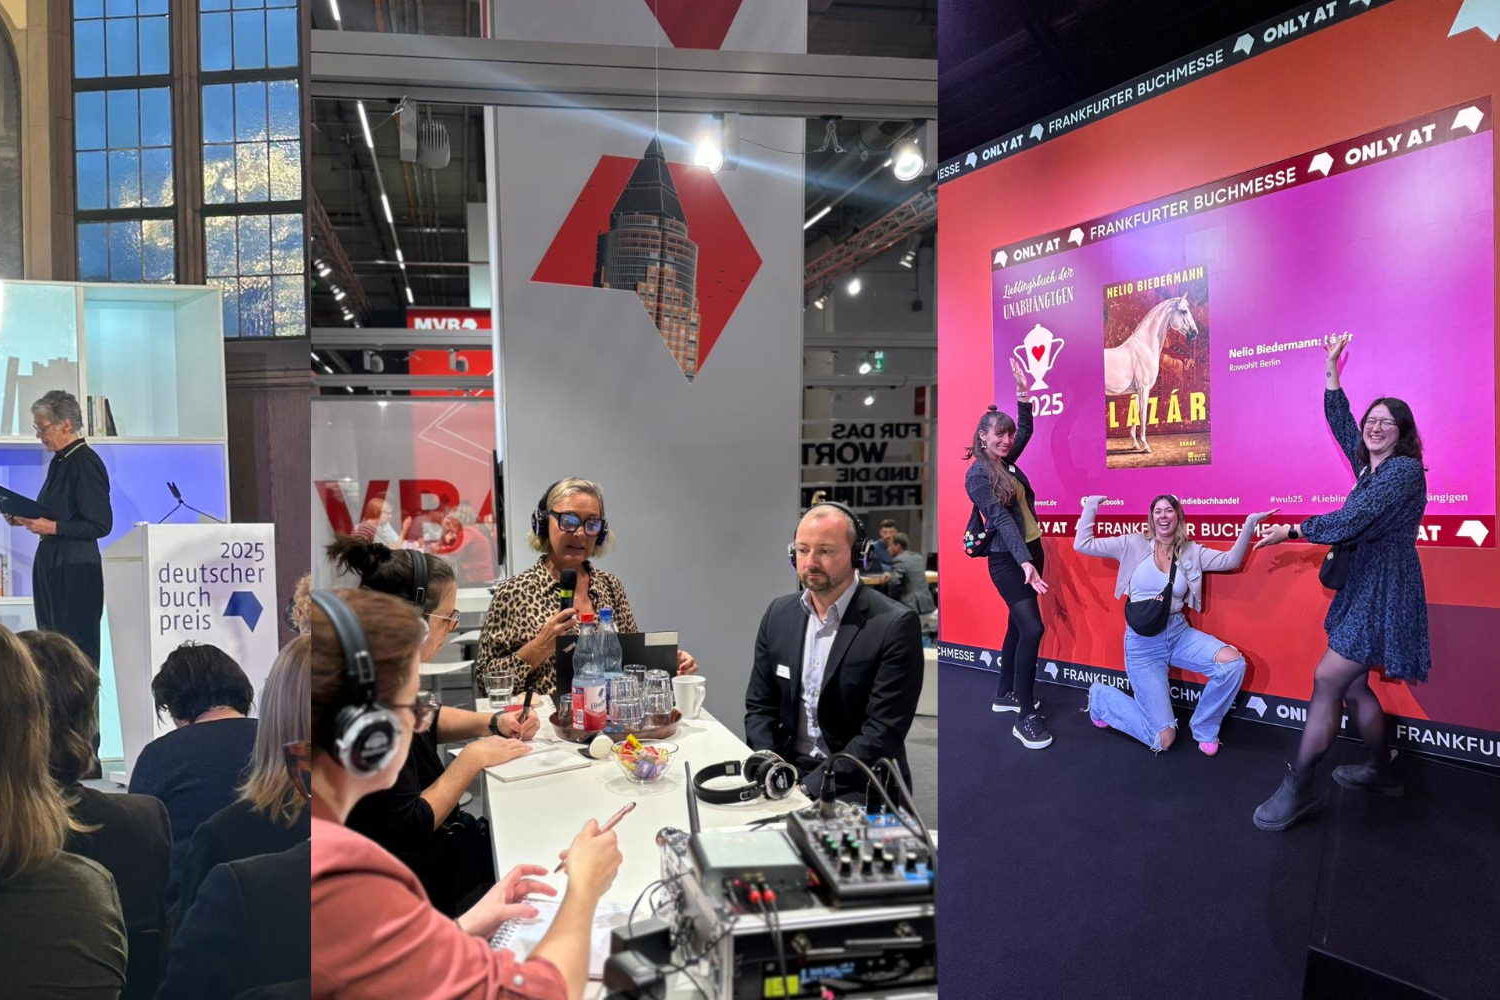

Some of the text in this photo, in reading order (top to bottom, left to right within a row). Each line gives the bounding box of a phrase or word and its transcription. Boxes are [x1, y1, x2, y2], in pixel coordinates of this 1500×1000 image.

[1263, 1, 1338, 43] ONLY AT
[1048, 49, 1224, 134] FRANKFURTER BUCHMESSE
[982, 140, 1008, 161] ONLY
[1010, 134, 1024, 150] AT
[1344, 123, 1436, 166] ONLY AT
[1090, 166, 1297, 240] FRANKFURTER BUCHMESSE
[1013, 237, 1061, 262] ONLY AT
[1002, 266, 1075, 299] Lieblingsbuch der
[1106, 266, 1204, 299] NELIO BIEDERMANN
[1002, 286, 1074, 320] UNABHÄNGIGEN
[1228, 347, 1255, 359] Nelio
[1256, 337, 1322, 355] Biedermann:
[1229, 358, 1281, 372] Rowohlt Berlin
[1029, 392, 1064, 418] 025
[1108, 388, 1206, 429] LÁZÁR
[1180, 497, 1240, 506] indiebuchhandel
[1270, 495, 1303, 503] #wub25
[1052, 521, 1068, 534] AT
[220, 541, 265, 562] 2025
[158, 562, 265, 583] deutscher
[159, 586, 211, 607] buch
[160, 608, 211, 636] preis
[1396, 724, 1500, 758] FRANKFU
